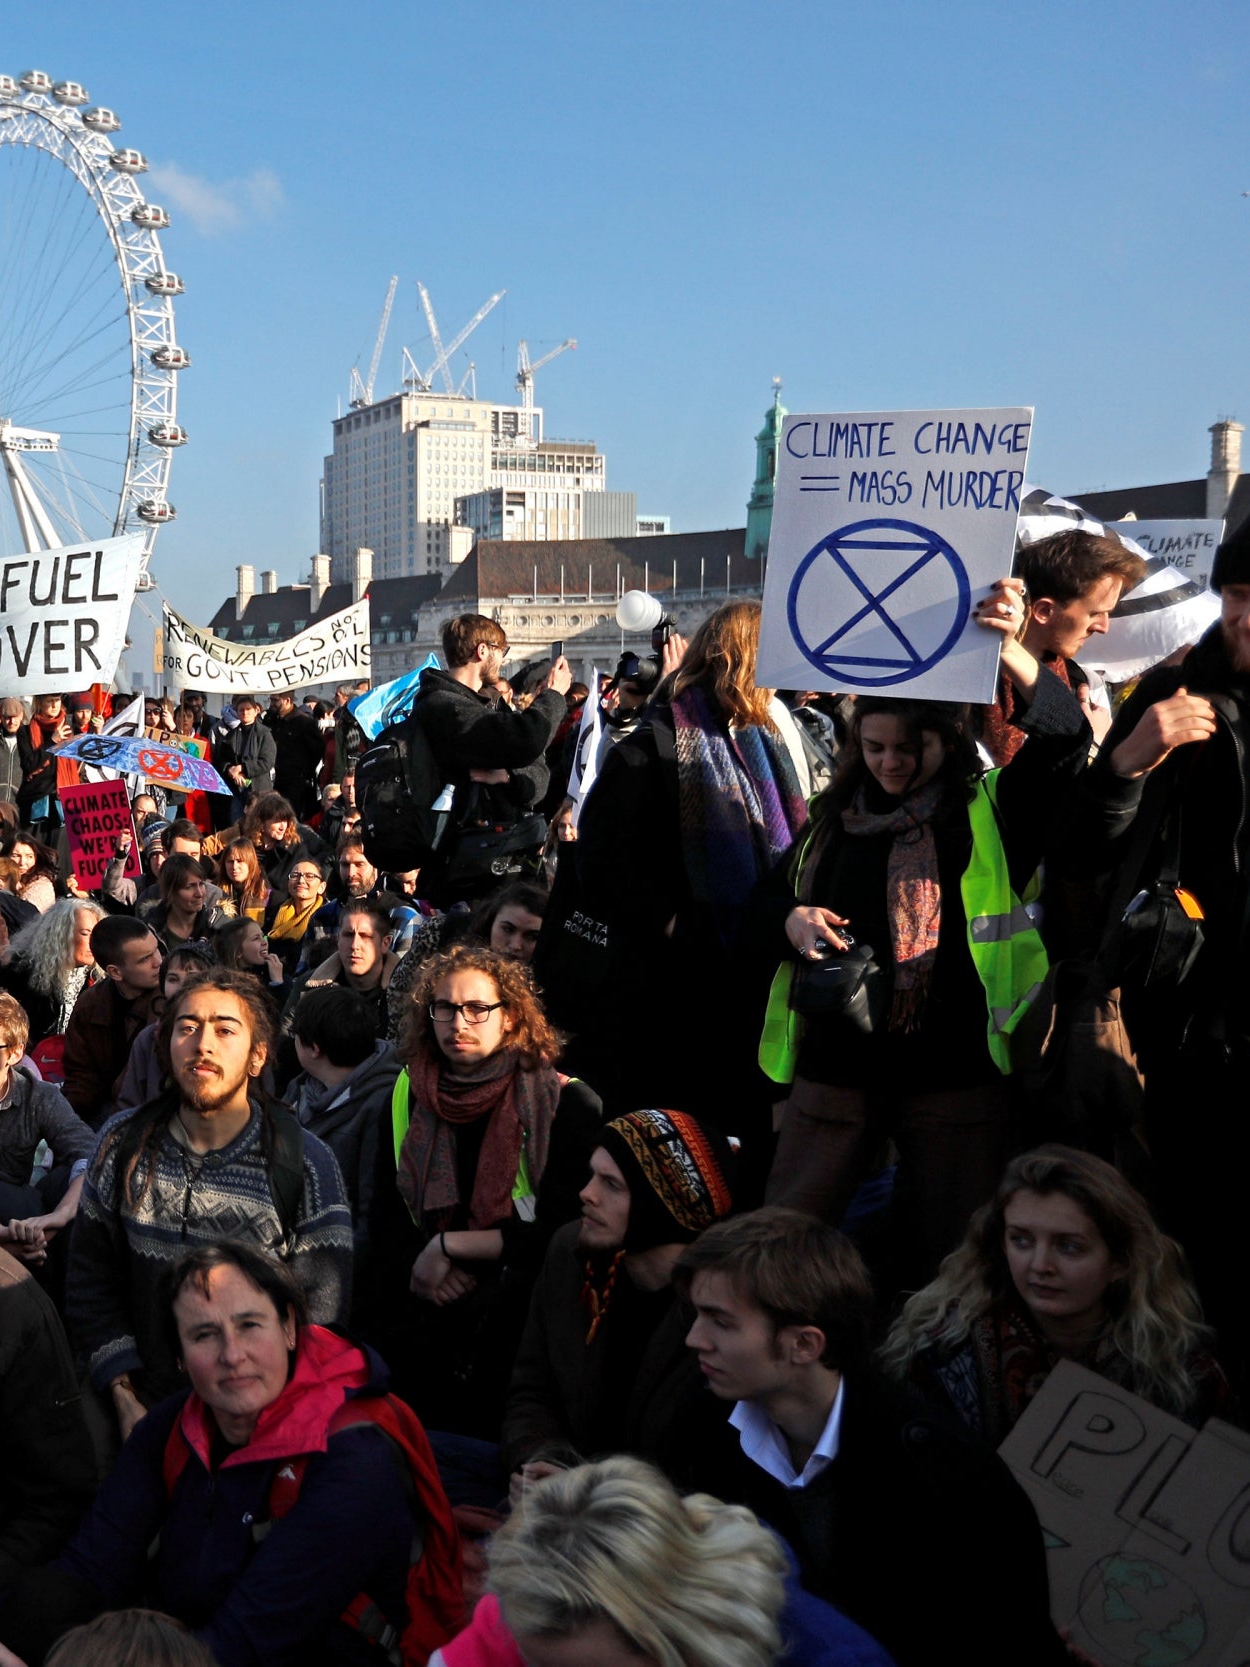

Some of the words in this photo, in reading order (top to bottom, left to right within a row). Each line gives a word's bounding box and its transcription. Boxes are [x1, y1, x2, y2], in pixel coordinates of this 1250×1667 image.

[786, 422, 896, 459] CLIMATE
[914, 421, 1031, 455] CHANGE
[848, 470, 912, 506] MASS
[922, 469, 1024, 512] MURDER
[0, 551, 118, 613] FUEL
[163, 655, 182, 671] FOR
[267, 643, 372, 688] PENSIONS
[64, 790, 128, 815] CLIMATE
[79, 835, 118, 855] WE'R
[78, 854, 135, 877] FUCD
[563, 919, 608, 947] ROMANA
[572, 911, 608, 935] PORTA
